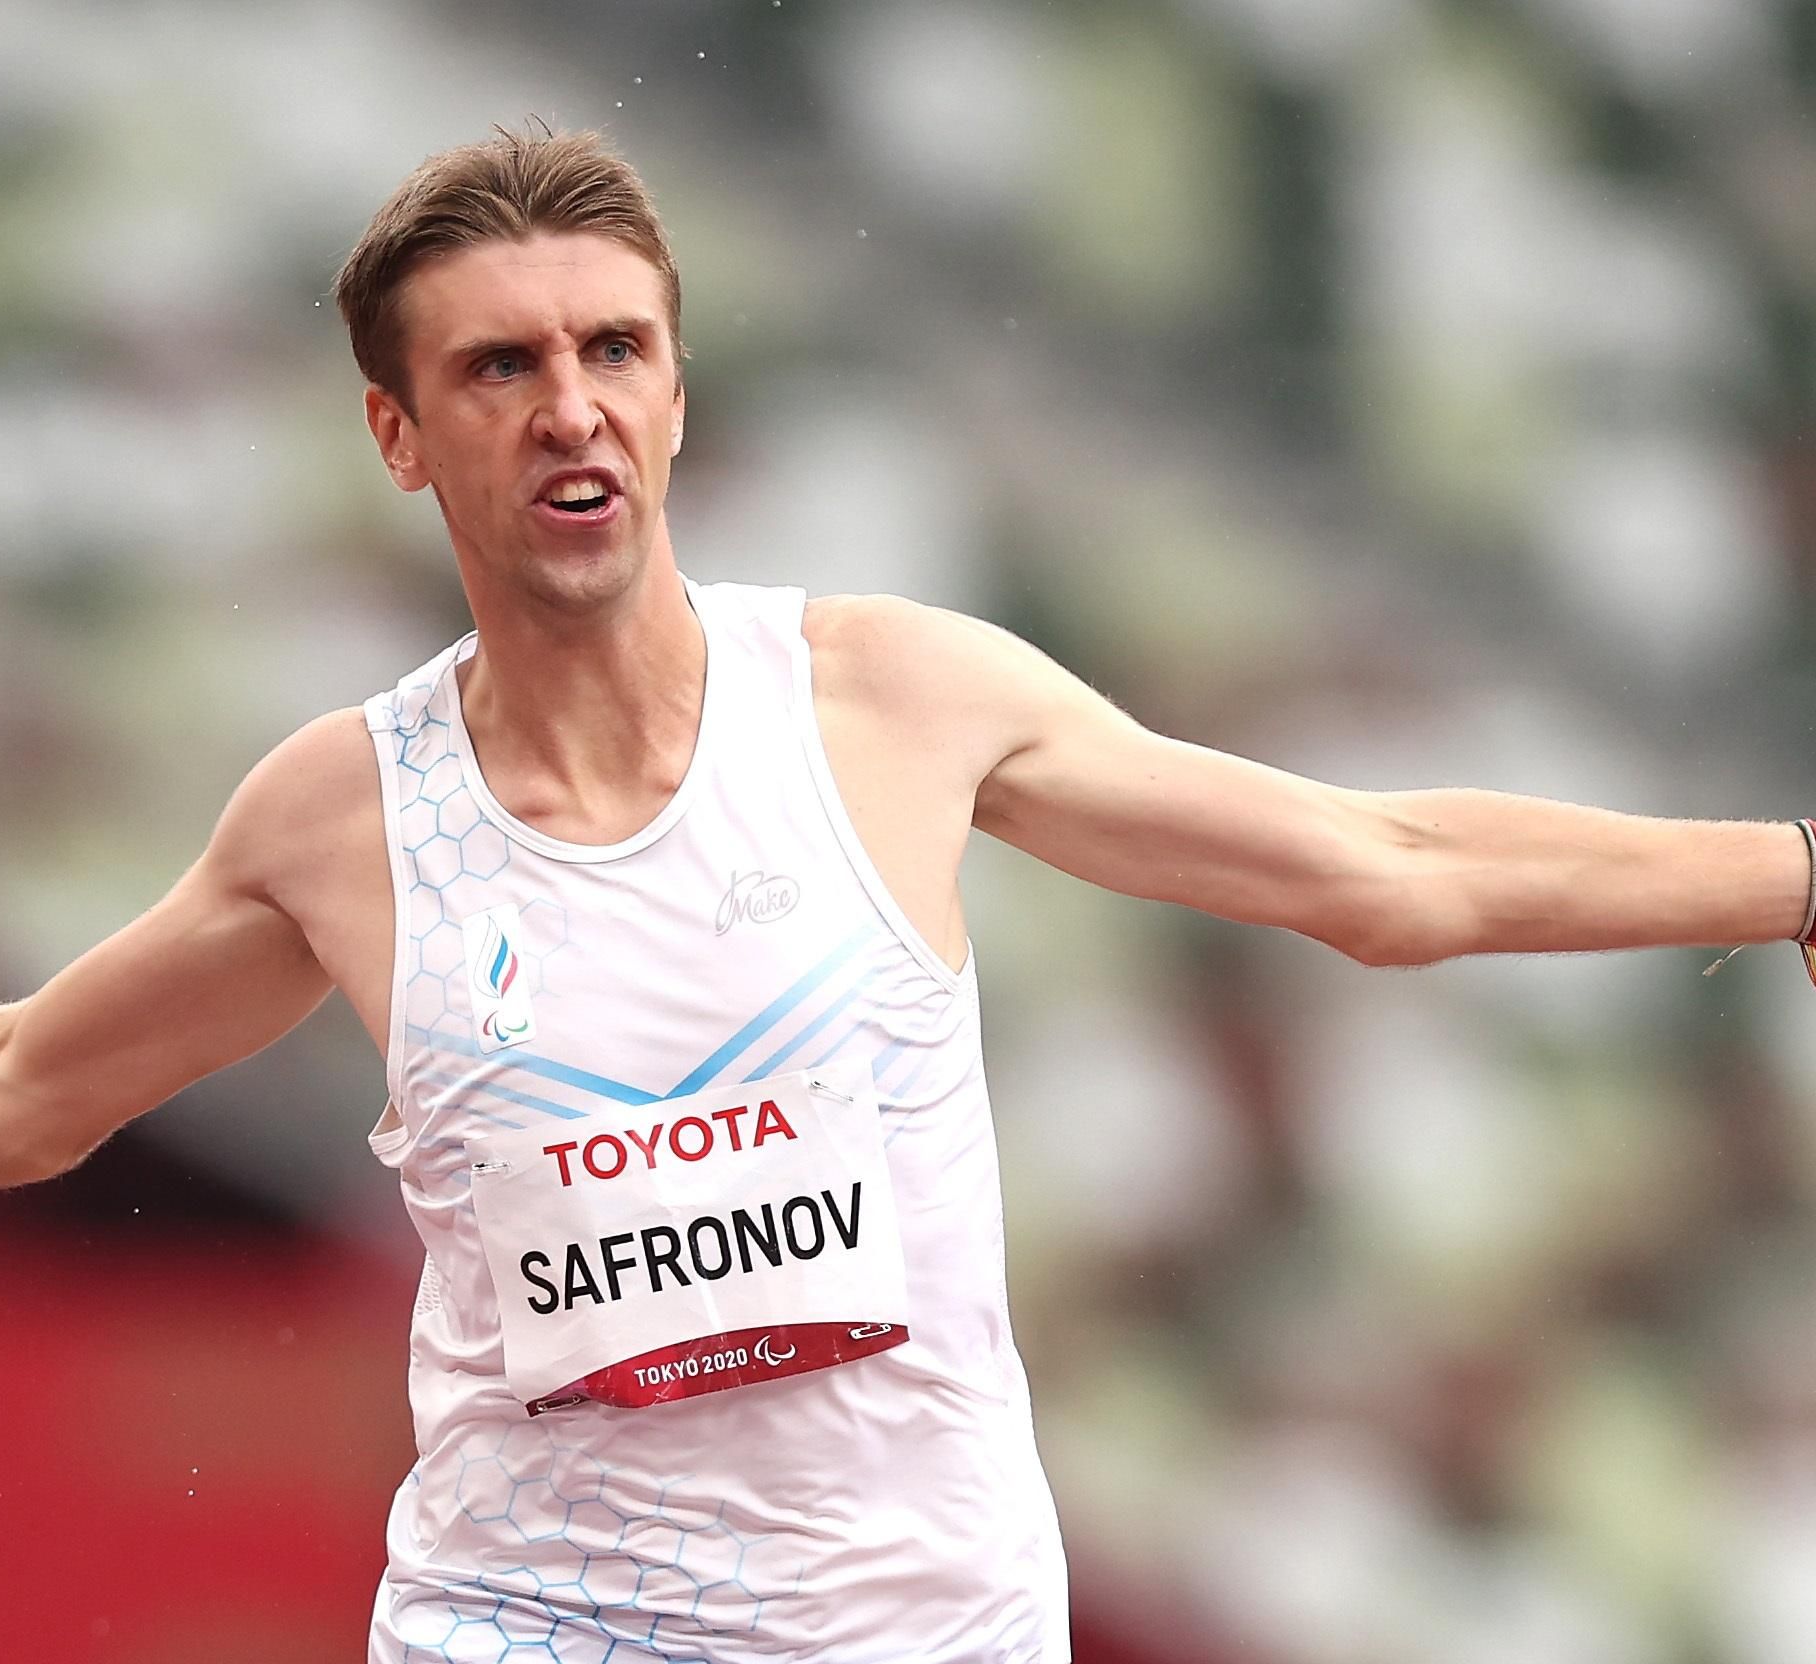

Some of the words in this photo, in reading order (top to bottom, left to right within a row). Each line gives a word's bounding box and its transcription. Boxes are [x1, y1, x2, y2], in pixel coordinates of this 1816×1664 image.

[543, 1099, 798, 1187] TOYOTA
[520, 1181, 861, 1315] SAFRONOV
[634, 1358, 699, 1388] TOKYO
[702, 1347, 748, 1375] 2020
